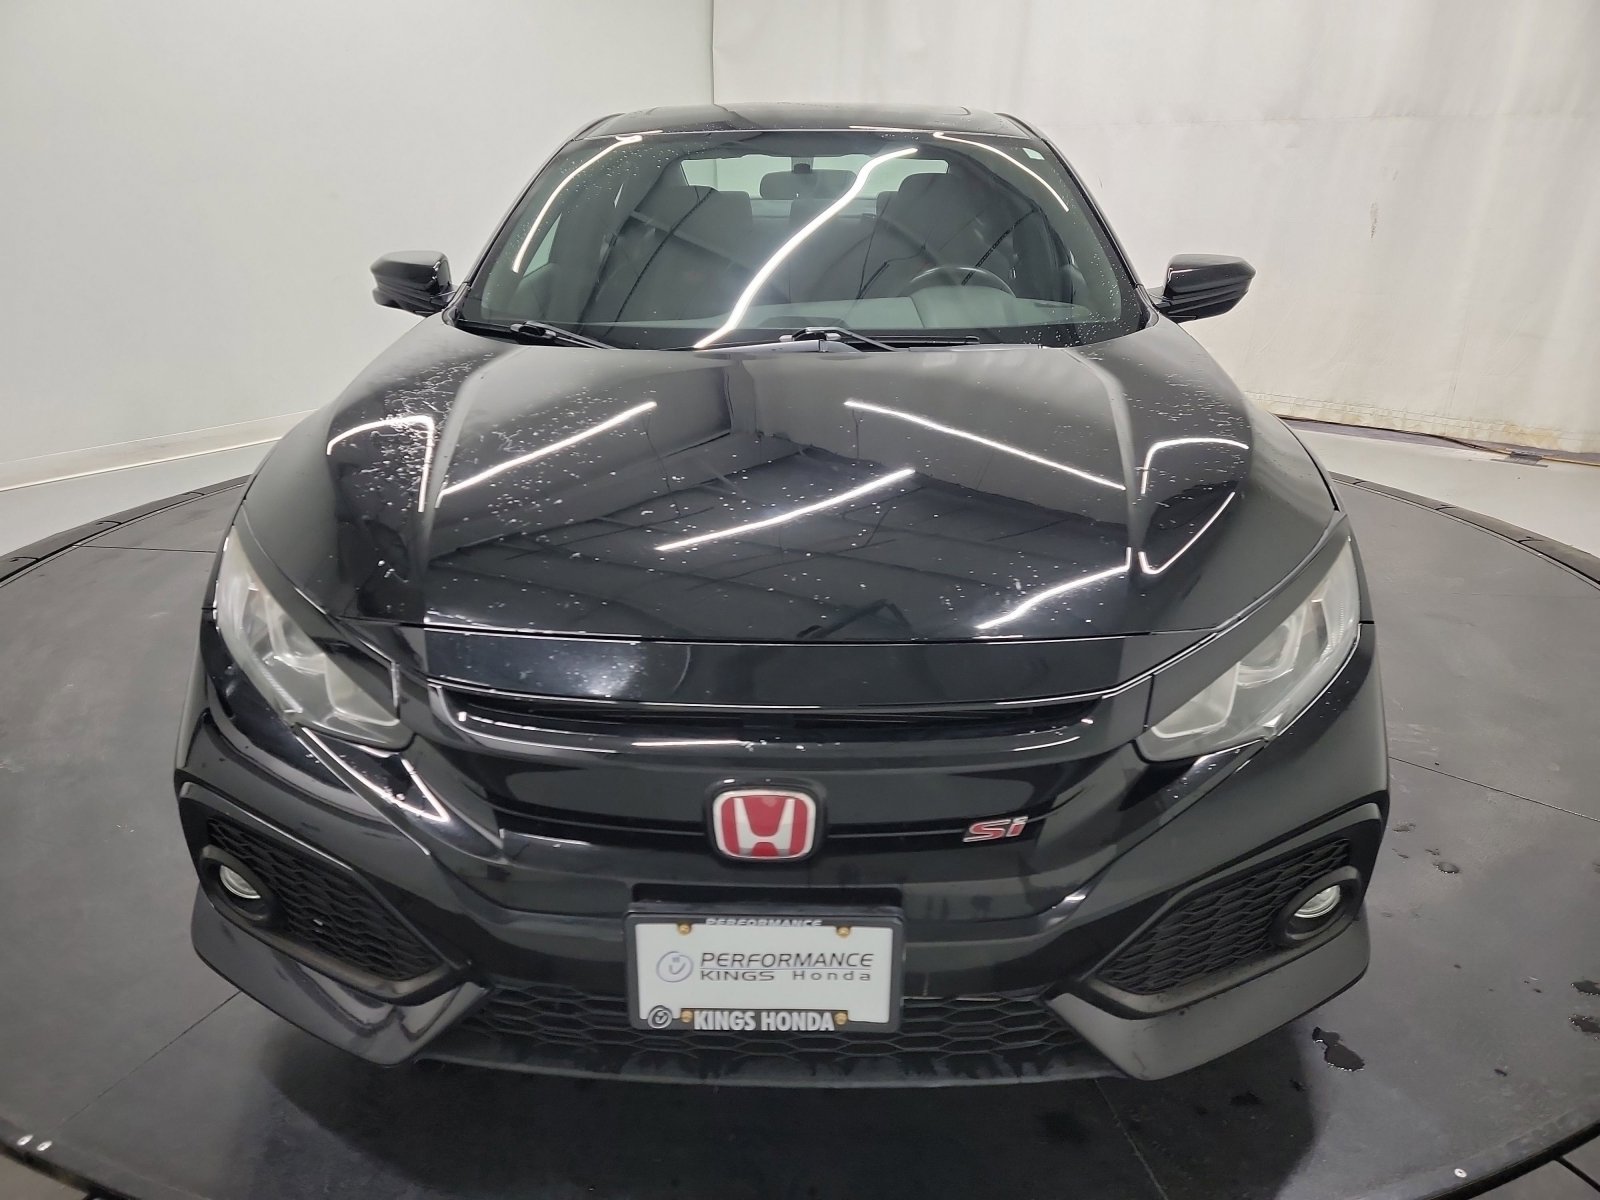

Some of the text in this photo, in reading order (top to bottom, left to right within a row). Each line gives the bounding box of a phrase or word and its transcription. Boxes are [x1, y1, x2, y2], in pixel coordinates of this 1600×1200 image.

[962, 815, 1028, 843] Si
[700, 952, 874, 968] PERFORMANCE
[700, 970, 872, 981] KINGS Honda
[693, 1010, 835, 1032] KINGS HONDA
